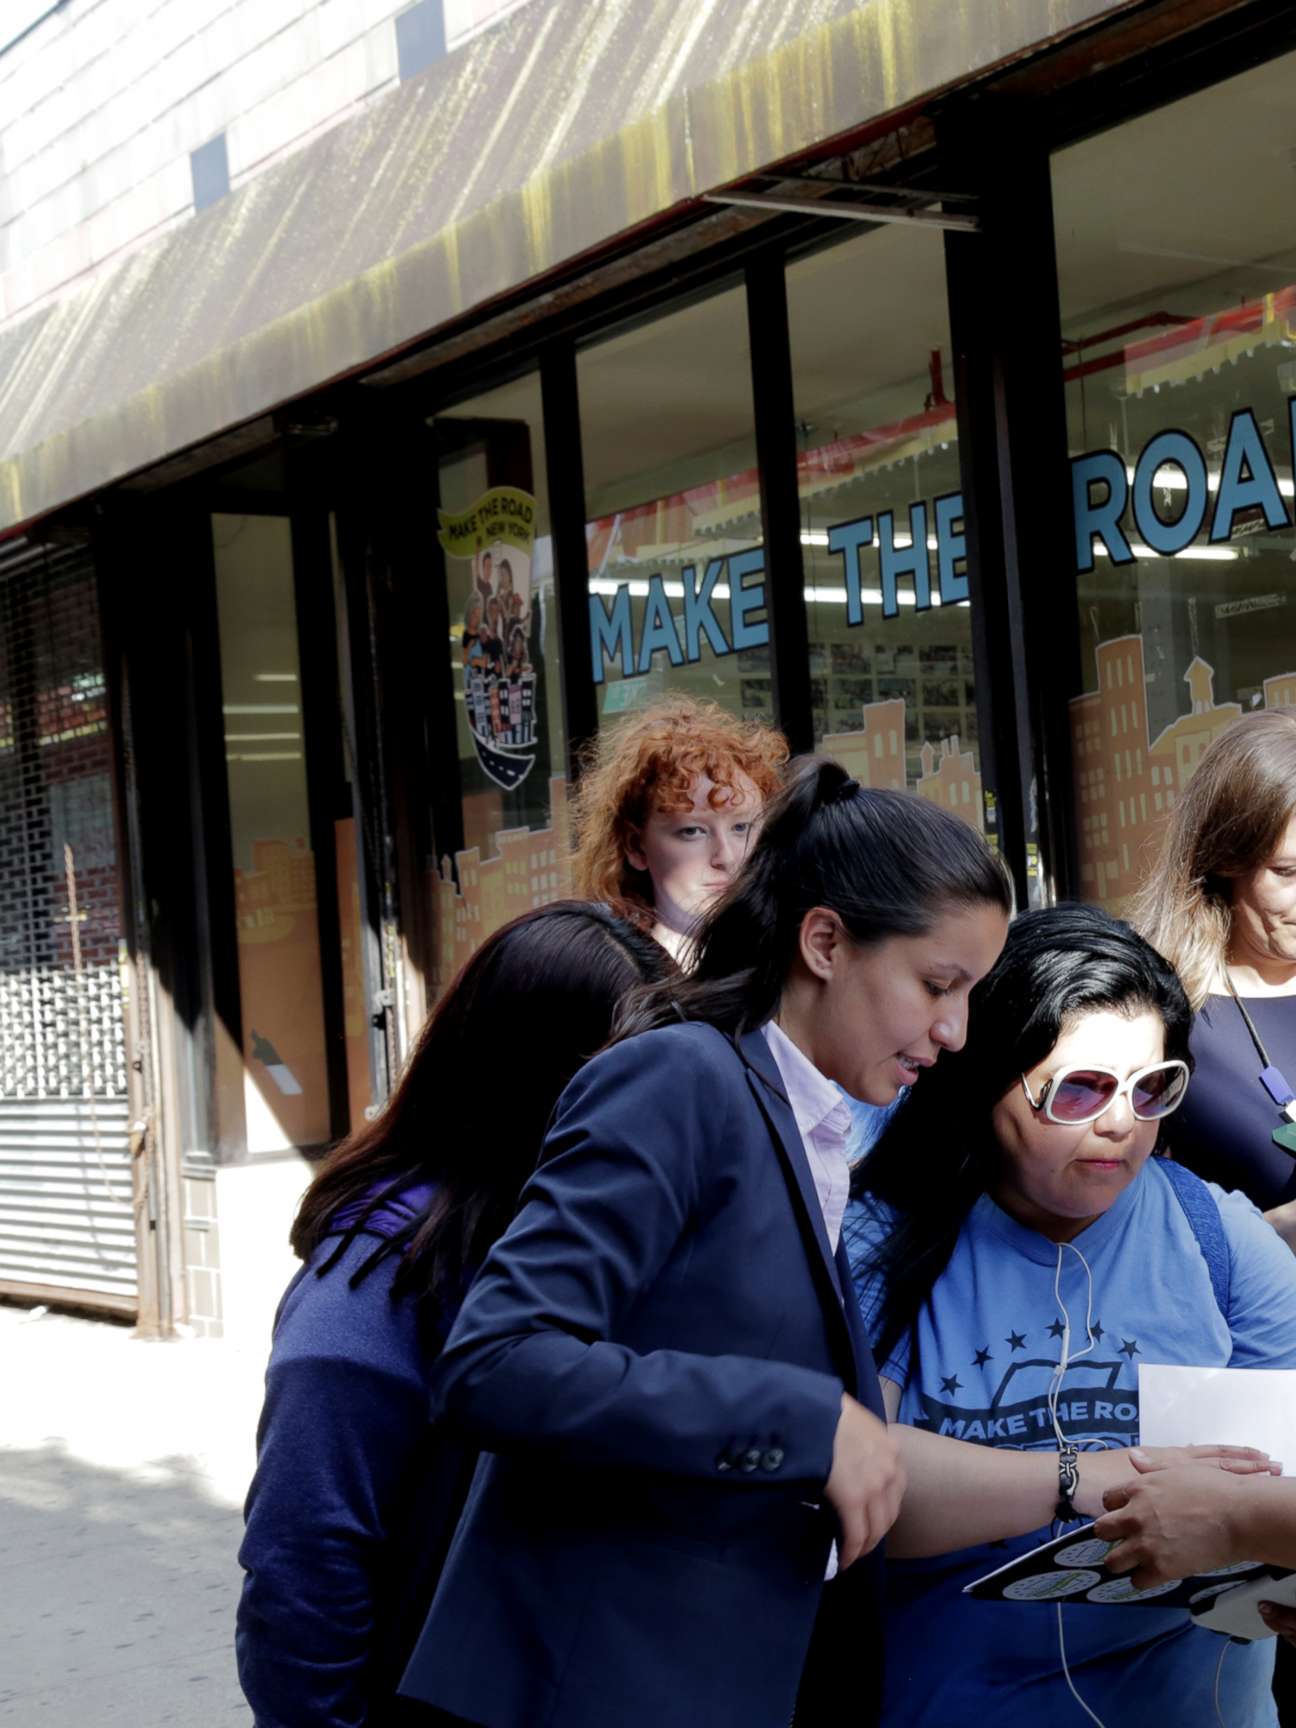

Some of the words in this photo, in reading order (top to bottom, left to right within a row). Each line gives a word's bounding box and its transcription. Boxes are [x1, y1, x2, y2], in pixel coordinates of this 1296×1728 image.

[449, 513, 477, 541] MAKE
[478, 497, 500, 525] THE
[501, 497, 533, 524] ROAD
[486, 521, 505, 537] NEW
[508, 521, 530, 542] YORK
[589, 546, 771, 684] MAKE
[828, 490, 970, 627] THE
[939, 1412, 1037, 1441] MAKE
[1028, 1401, 1089, 1432] THE
[1092, 1400, 1139, 1436] RO
